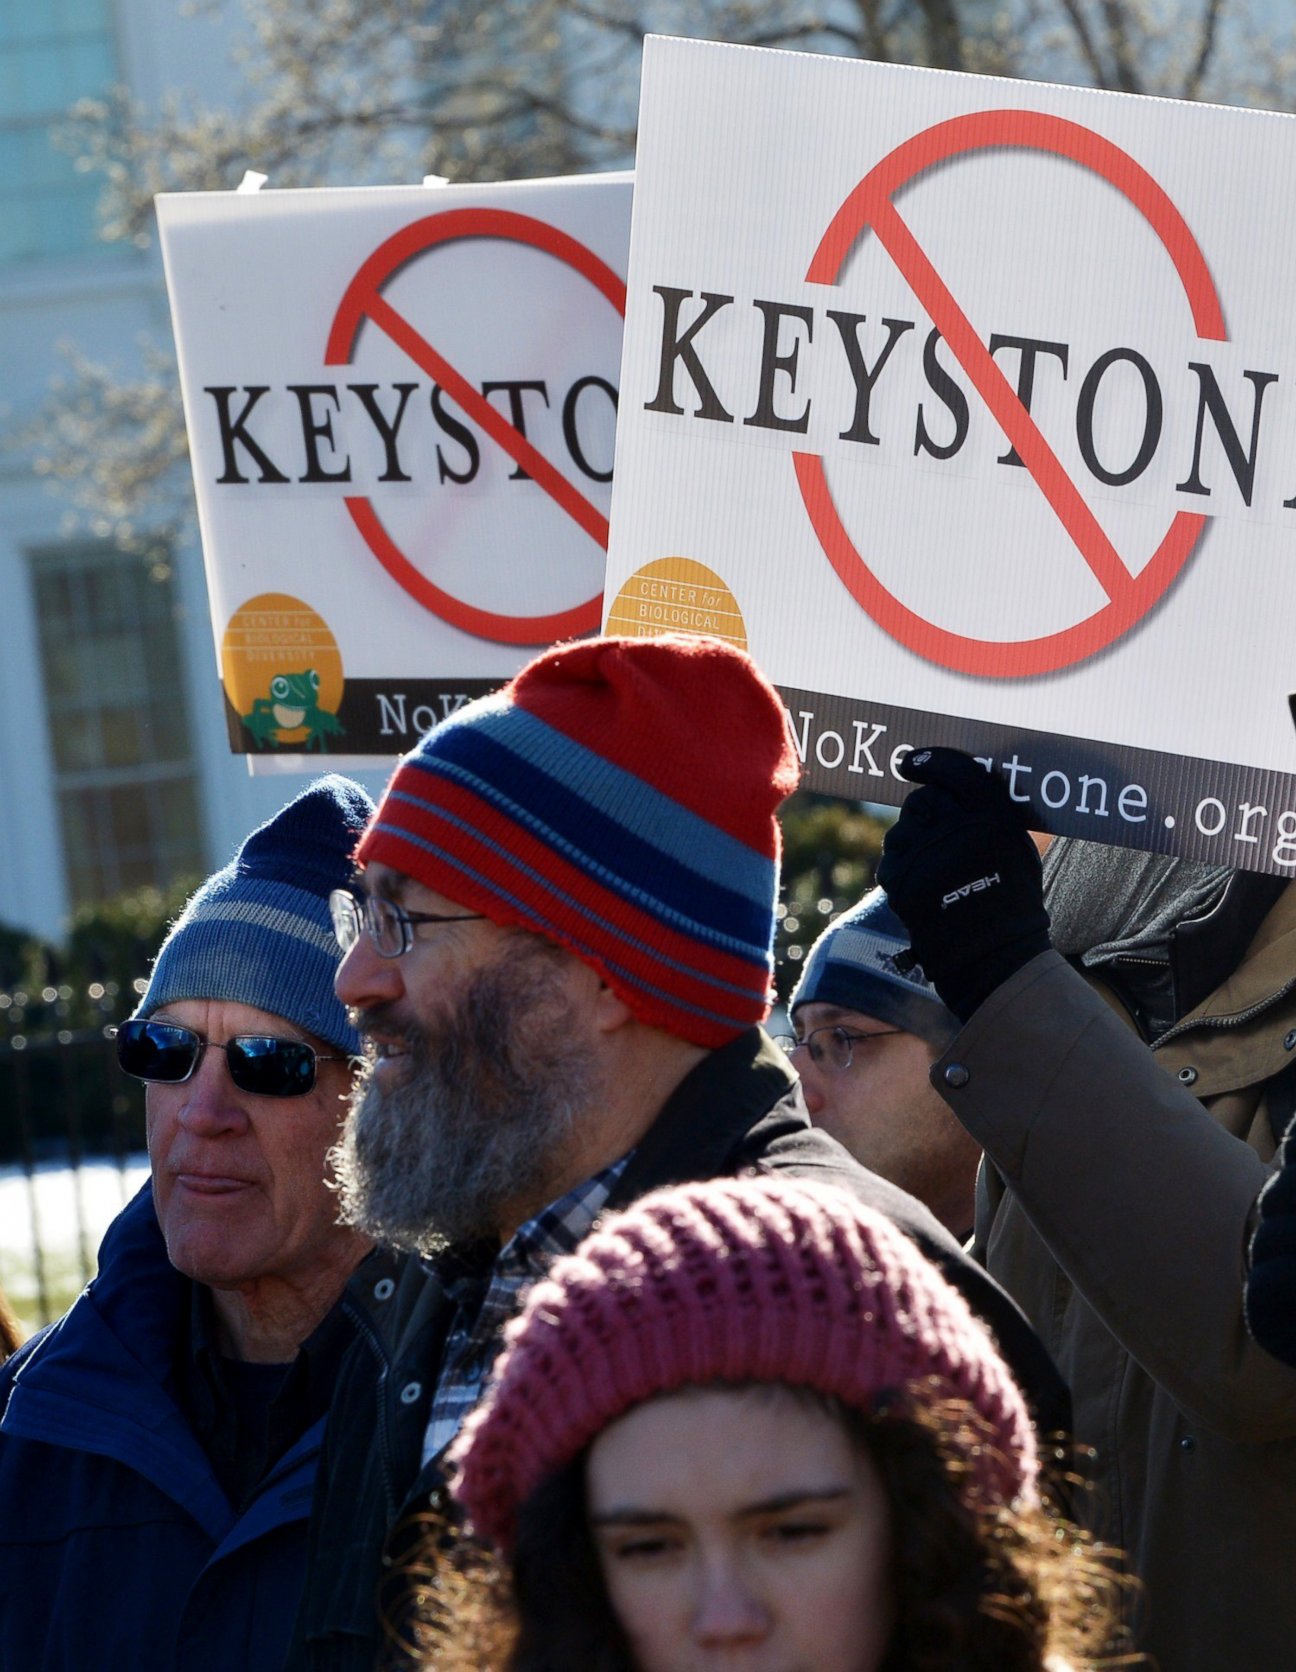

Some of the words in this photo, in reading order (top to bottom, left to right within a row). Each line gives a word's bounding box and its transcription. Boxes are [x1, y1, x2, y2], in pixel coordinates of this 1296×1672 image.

[640, 582, 697, 603] CENTER
[701, 591, 721, 606] for
[639, 604, 720, 630] BIOLOGICAL
[943, 872, 1000, 904] HEAD
